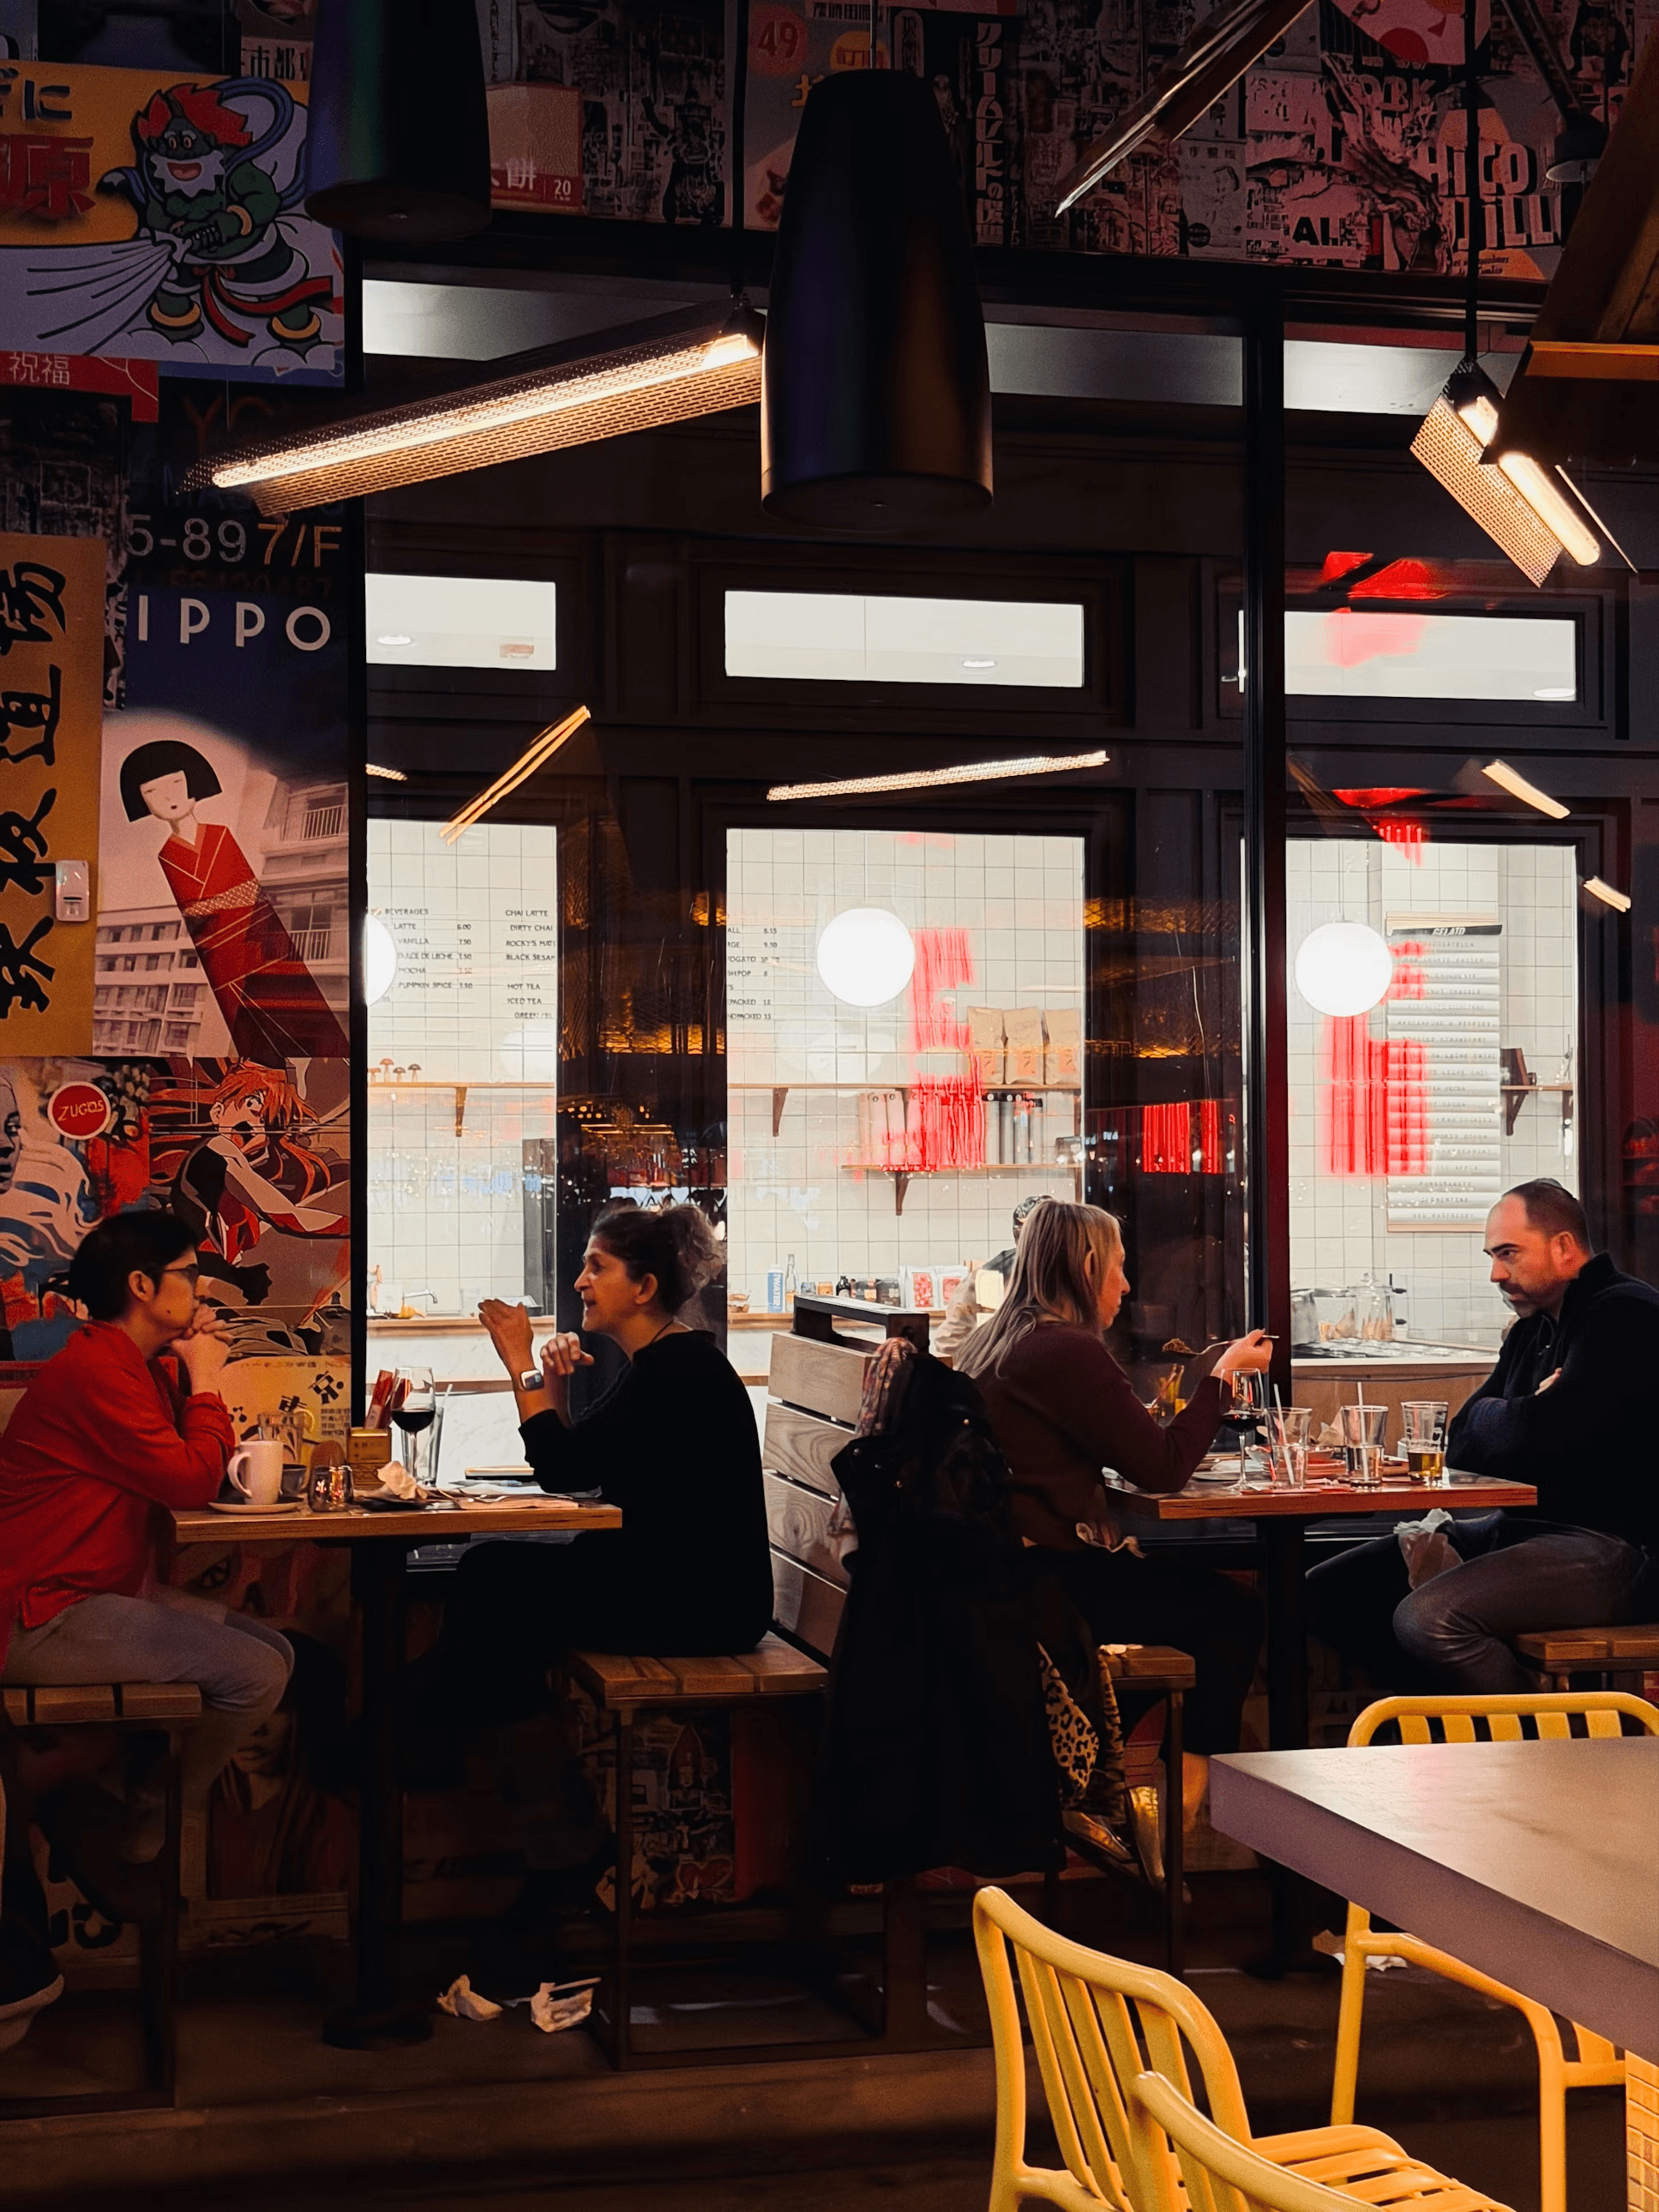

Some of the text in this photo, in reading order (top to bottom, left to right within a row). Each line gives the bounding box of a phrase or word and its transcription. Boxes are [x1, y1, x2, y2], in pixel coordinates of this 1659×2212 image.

[757, 21, 799, 58] 49
[554, 178, 572, 195] 20
[9, 352, 70, 386] 祝福
[1432, 927, 1466, 935] GELATO
